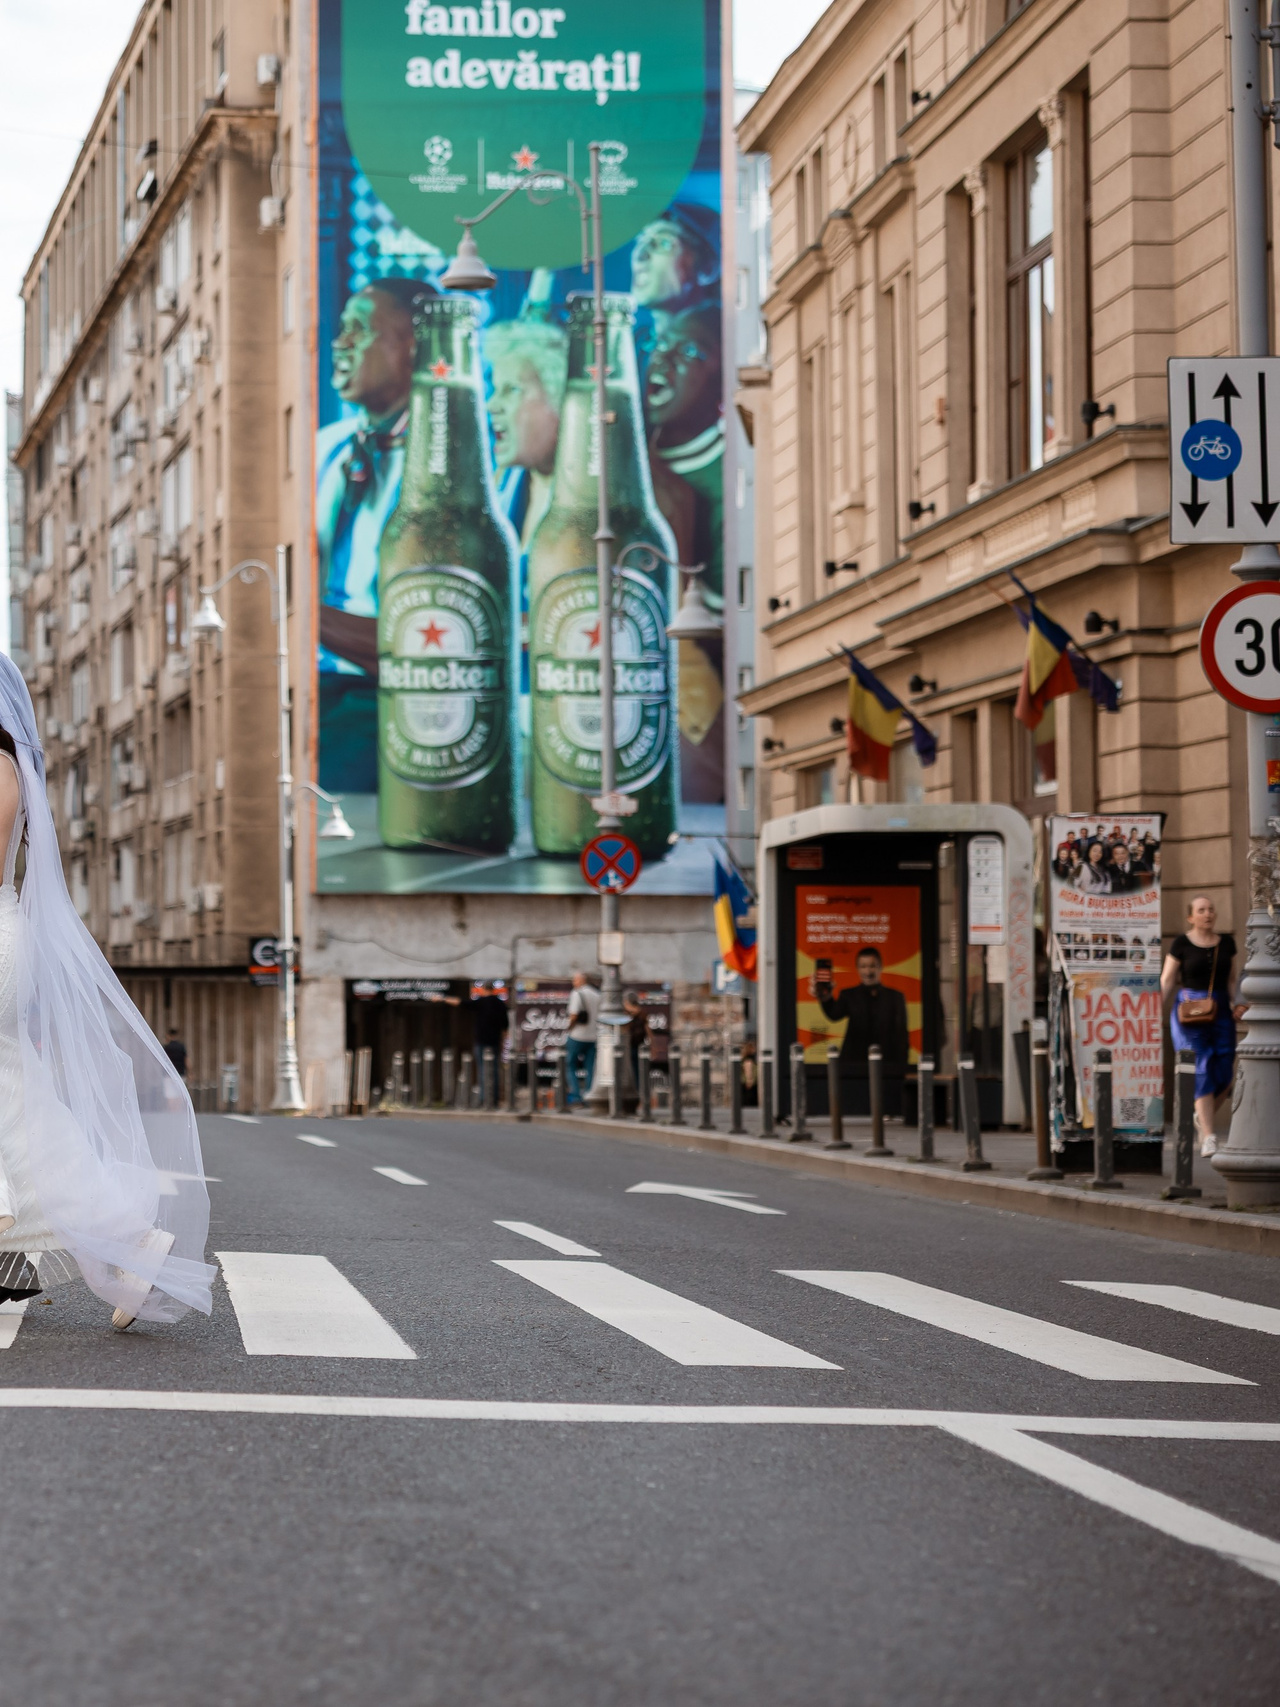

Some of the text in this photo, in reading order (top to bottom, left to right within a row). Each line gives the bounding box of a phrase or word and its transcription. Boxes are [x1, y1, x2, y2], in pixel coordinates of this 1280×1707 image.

[405, 0, 566, 39] fanilor
[405, 49, 642, 107] adevărați!
[537, 661, 666, 692] Heinken
[1082, 1019, 1163, 1047] JONE
